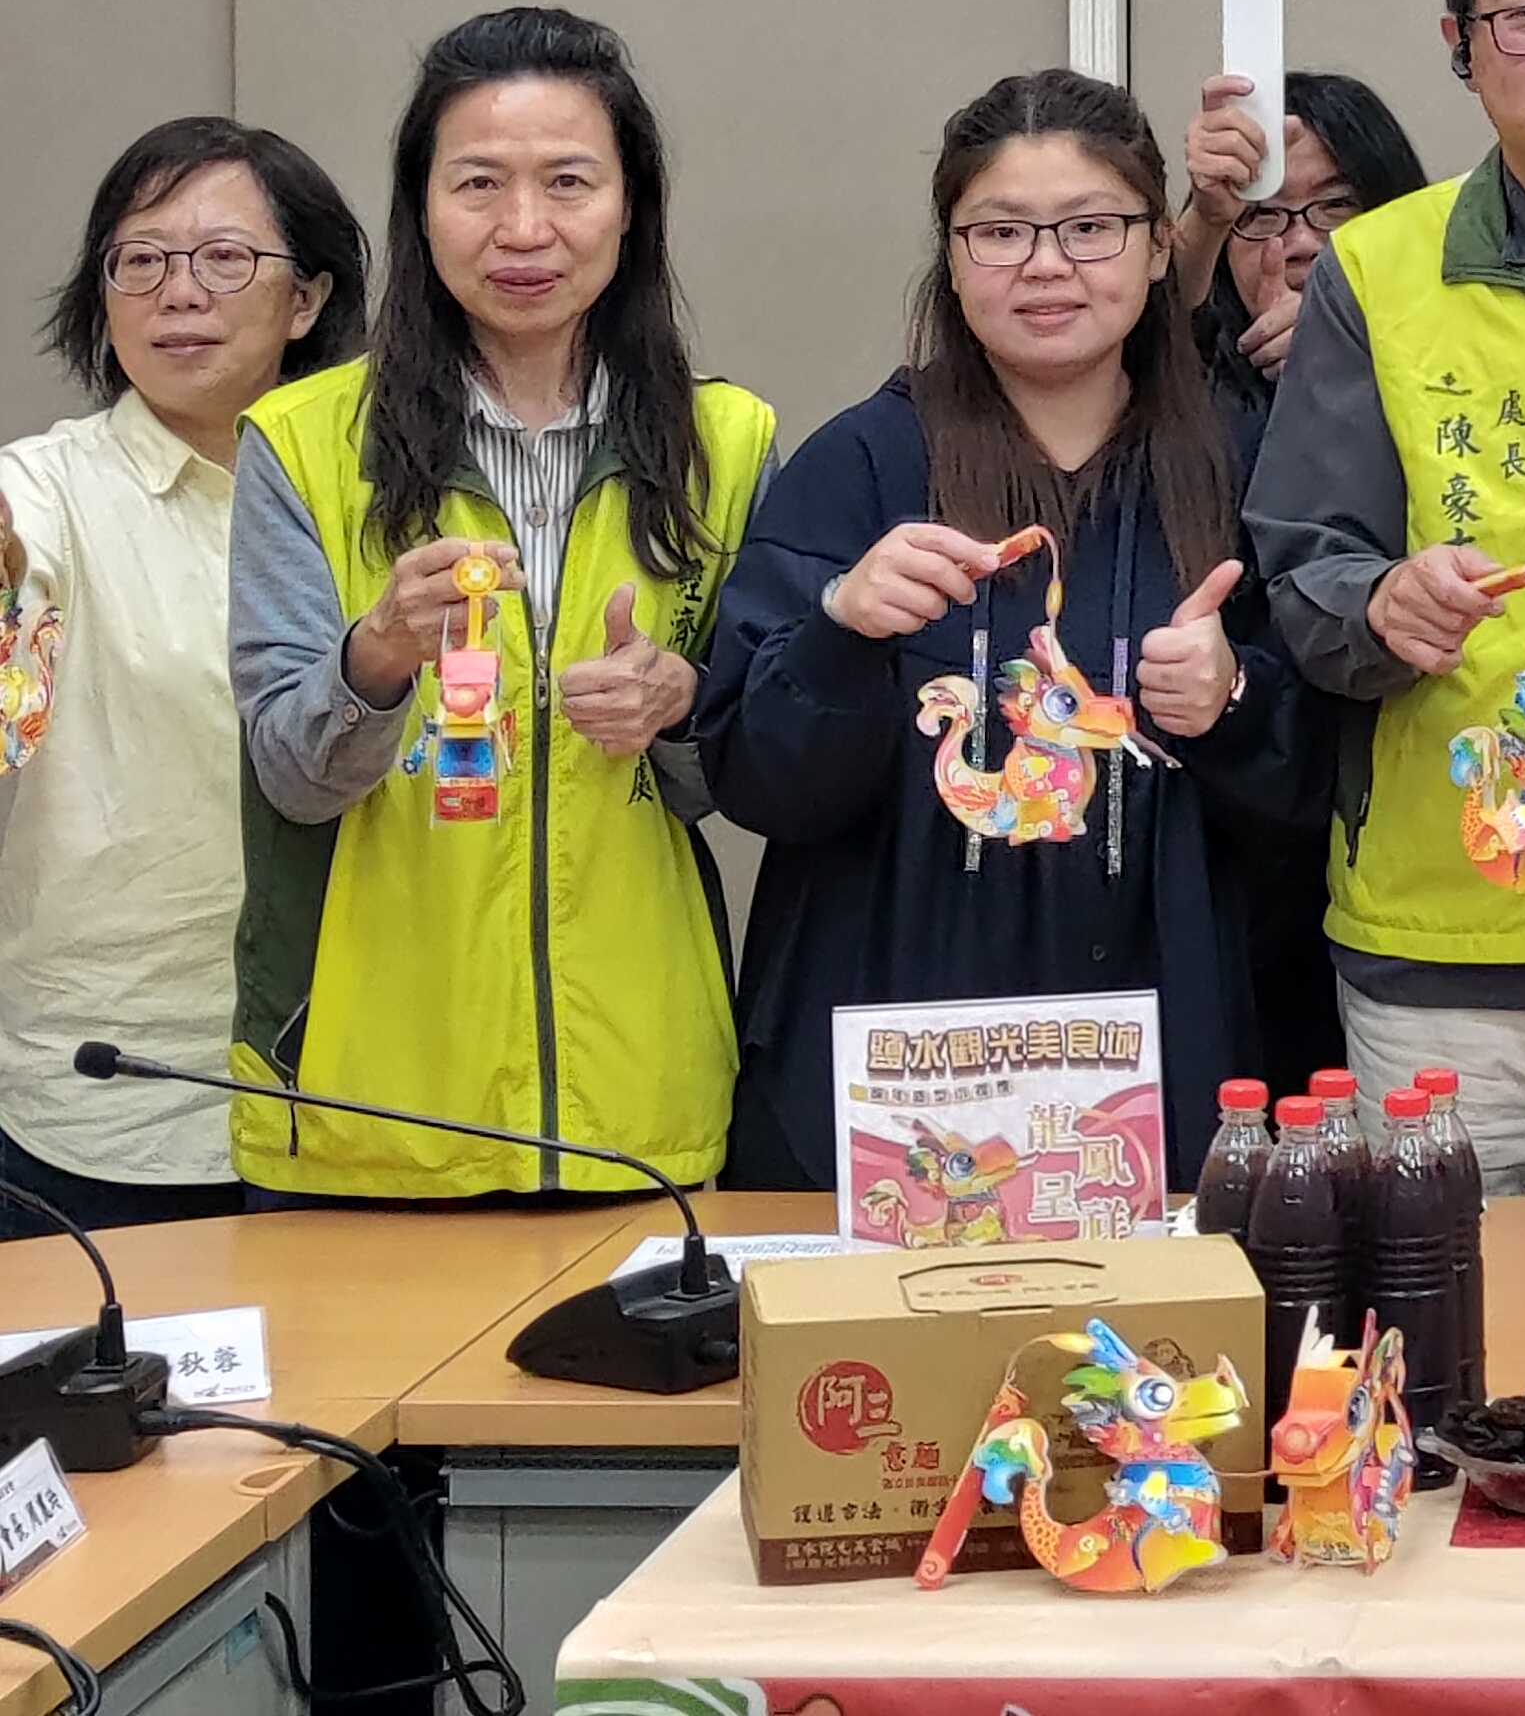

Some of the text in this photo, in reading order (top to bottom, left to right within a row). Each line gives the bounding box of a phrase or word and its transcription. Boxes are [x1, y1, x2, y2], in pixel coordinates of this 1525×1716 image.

[867, 1019, 1143, 1080] 鹽水觀光美食城
[817, 1374, 902, 1439] 阿三
